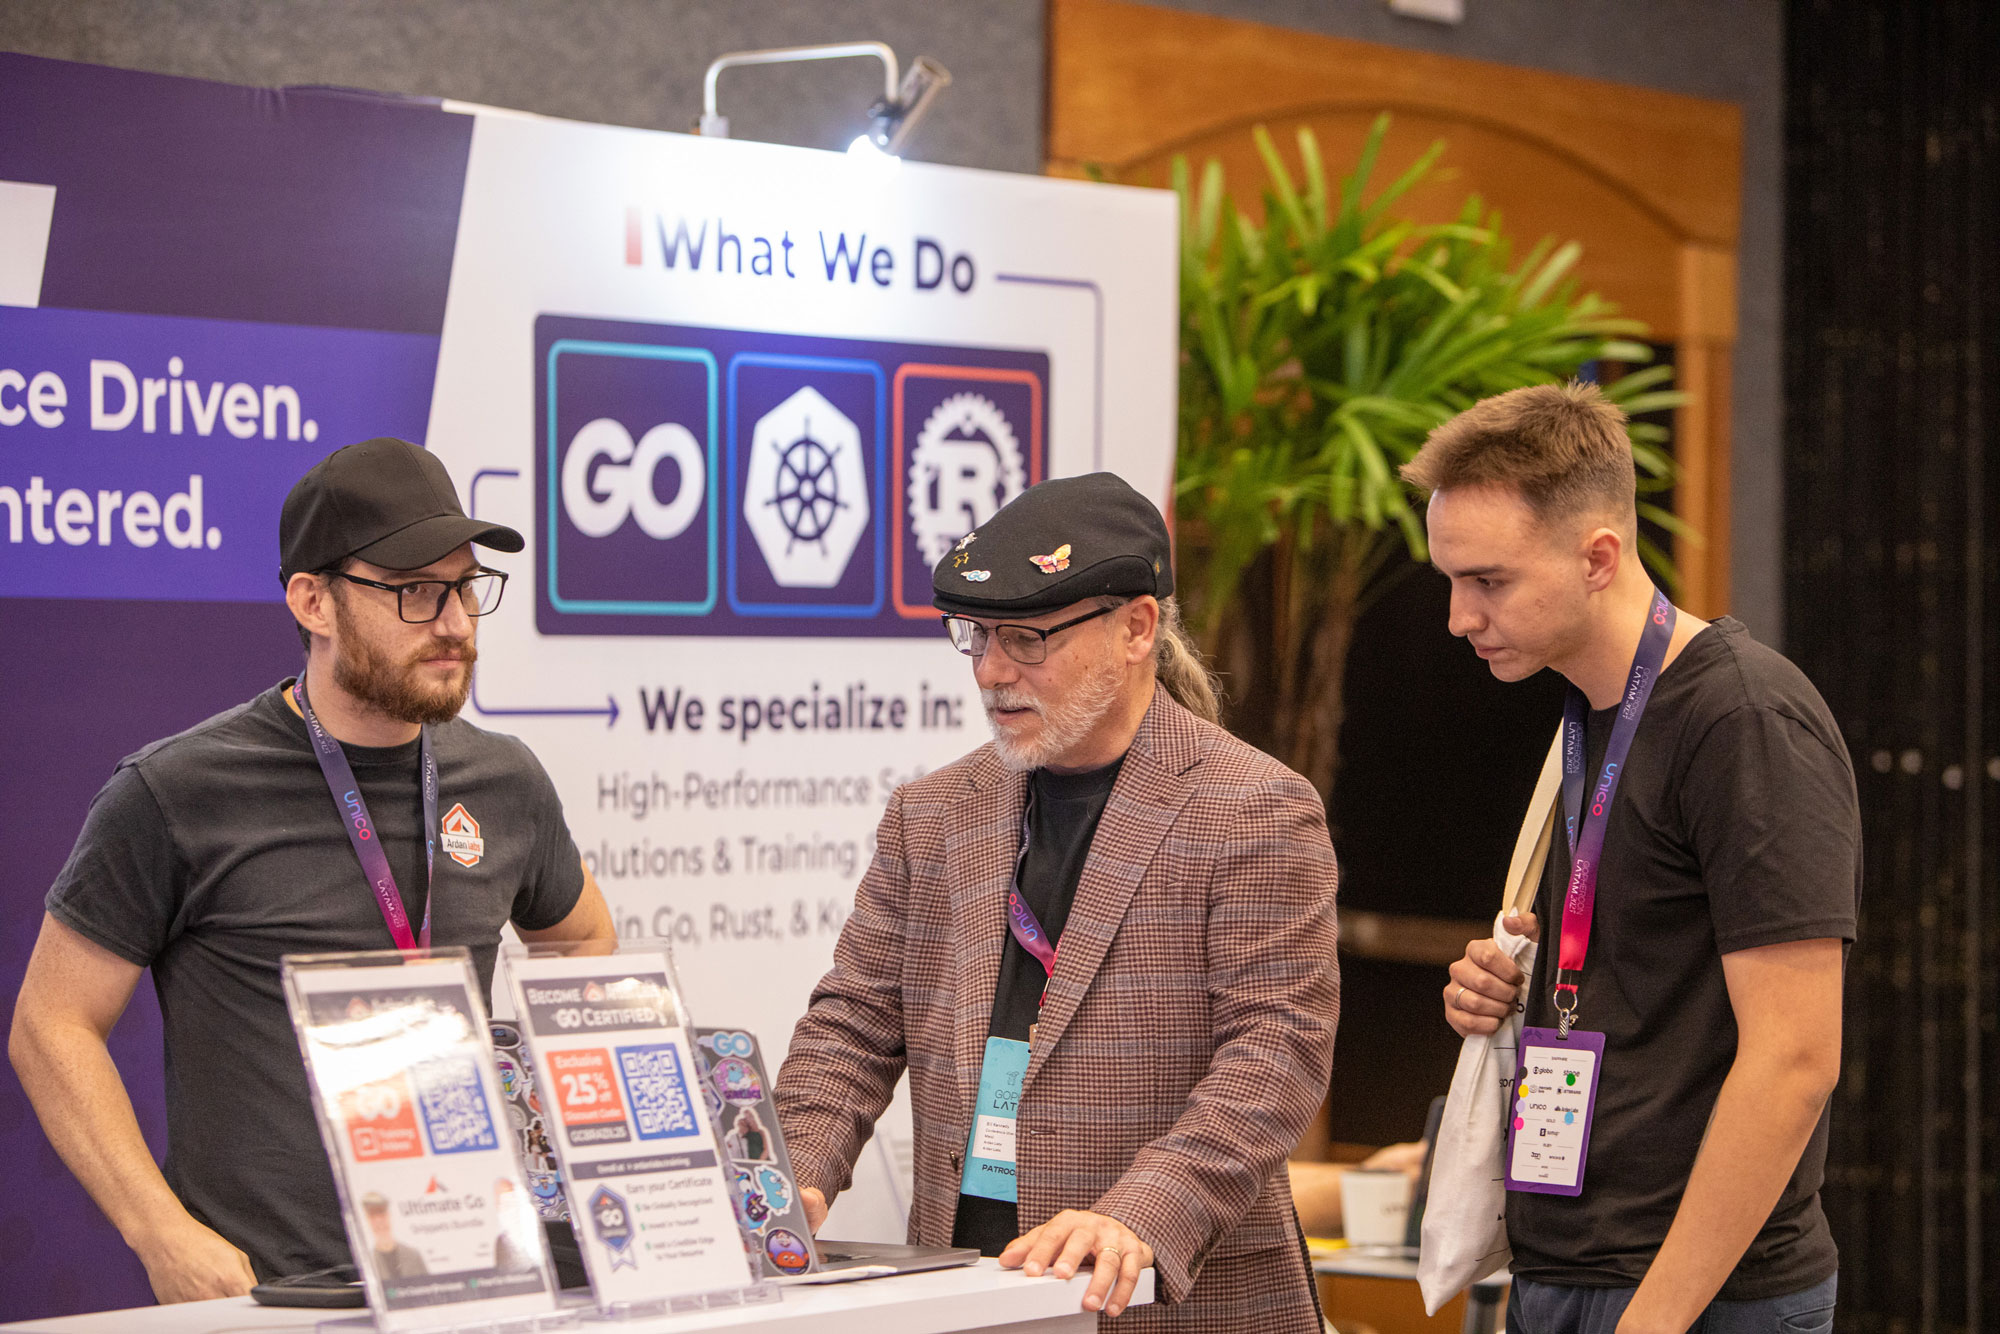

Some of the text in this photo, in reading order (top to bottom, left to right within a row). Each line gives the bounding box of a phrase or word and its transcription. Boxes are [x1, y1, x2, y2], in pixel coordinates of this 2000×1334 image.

[656, 213, 976, 293] What We Do
[0, 356, 319, 443] ce Driven.
[561, 418, 706, 540] GO
[0, 474, 222, 550] ntered.
[1652, 592, 1669, 625] nico
[639, 681, 963, 743] We specialize in:
[597, 768, 872, 821] High-Performance
[1592, 763, 1618, 816] unico
[343, 790, 371, 840] unico
[585, 837, 704, 879] olutions
[741, 831, 859, 880] Training
[1571, 859, 1583, 895] LATAM
[708, 902, 785, 942] Rust,
[1009, 893, 1038, 942] unico
[713, 1032, 752, 1056] GO
[993, 1099, 1017, 1112] LAT
[994, 1089, 1019, 1101] GOP
[981, 1164, 1016, 1177] PATROC
